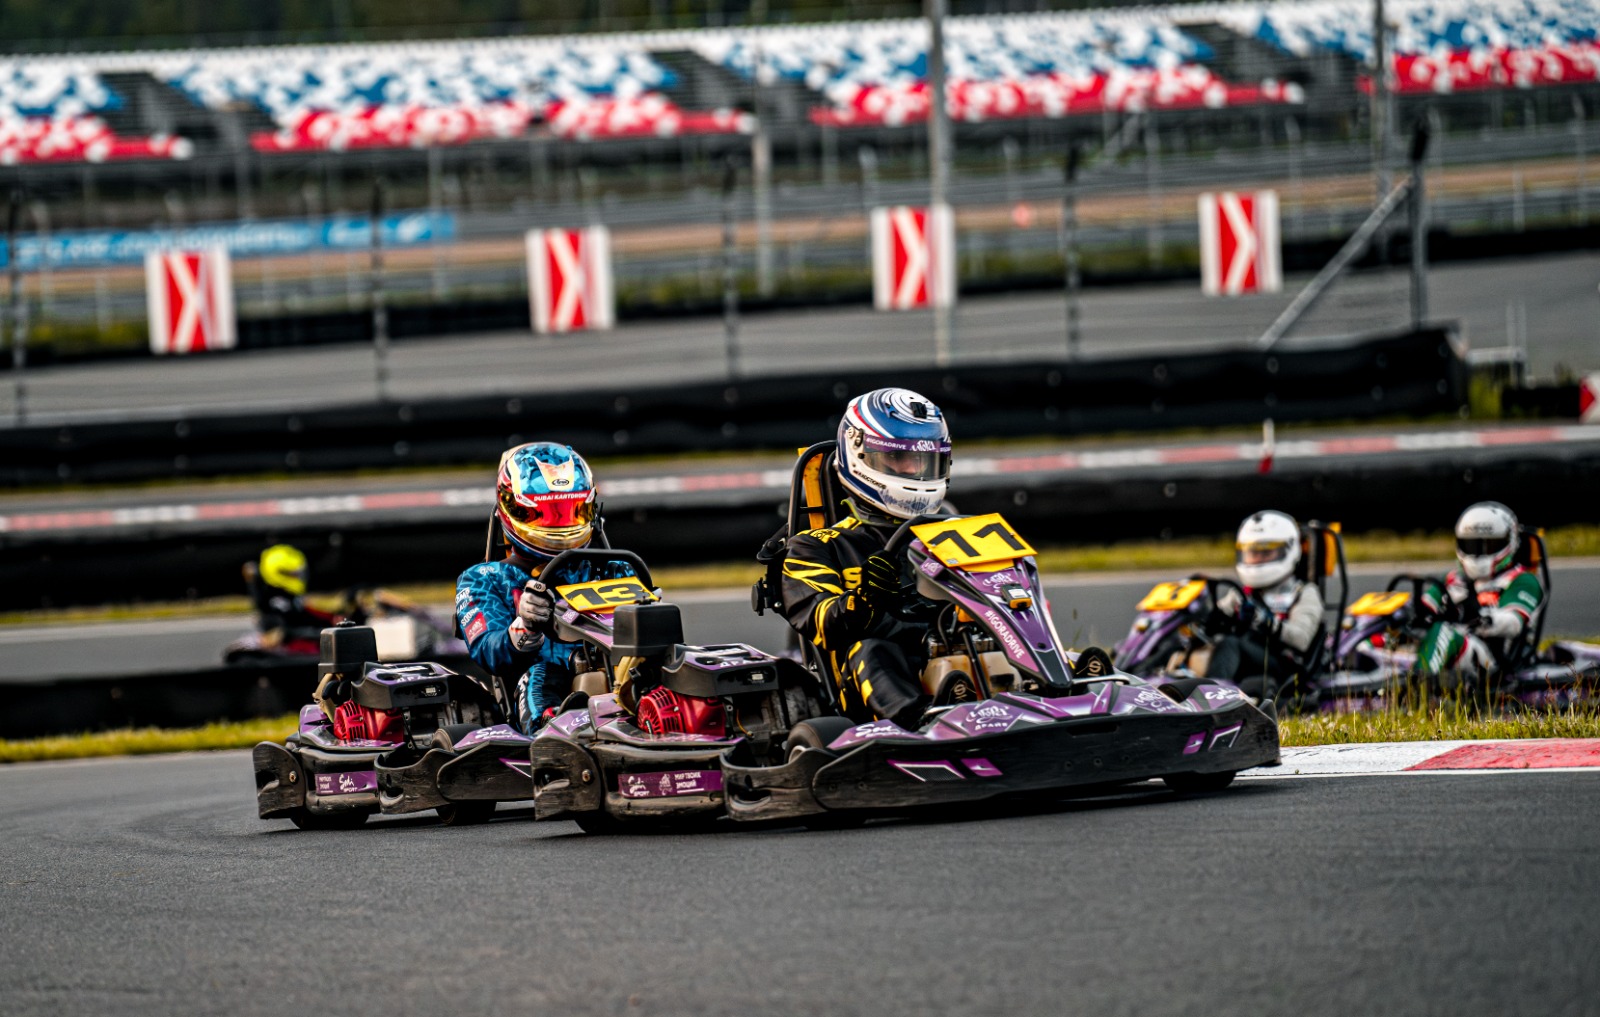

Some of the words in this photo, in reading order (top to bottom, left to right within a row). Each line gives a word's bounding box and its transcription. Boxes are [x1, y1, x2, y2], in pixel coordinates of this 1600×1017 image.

[927, 522, 1026, 557] 11
[565, 582, 650, 606] 13
[985, 610, 1025, 659] #IGORADRIVE
